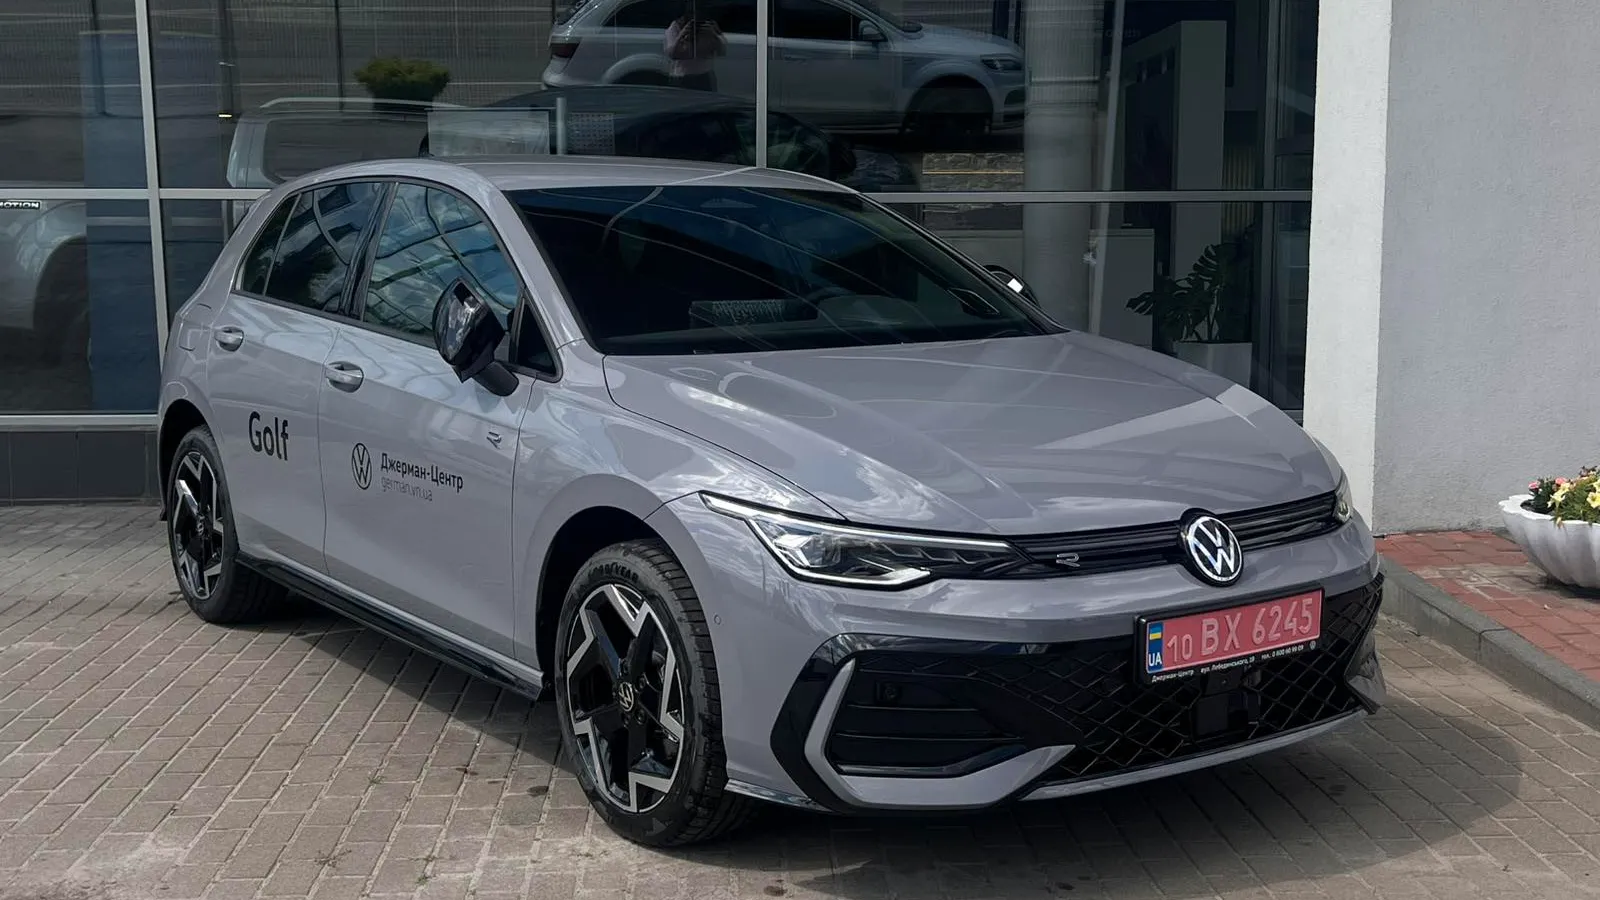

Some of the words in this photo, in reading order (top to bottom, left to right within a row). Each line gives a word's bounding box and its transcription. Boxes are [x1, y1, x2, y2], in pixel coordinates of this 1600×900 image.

[248, 411, 289, 461] Golf
[1166, 633, 1193, 662] 10
[1252, 597, 1313, 645] 6245
[1148, 652, 1162, 667] UA
